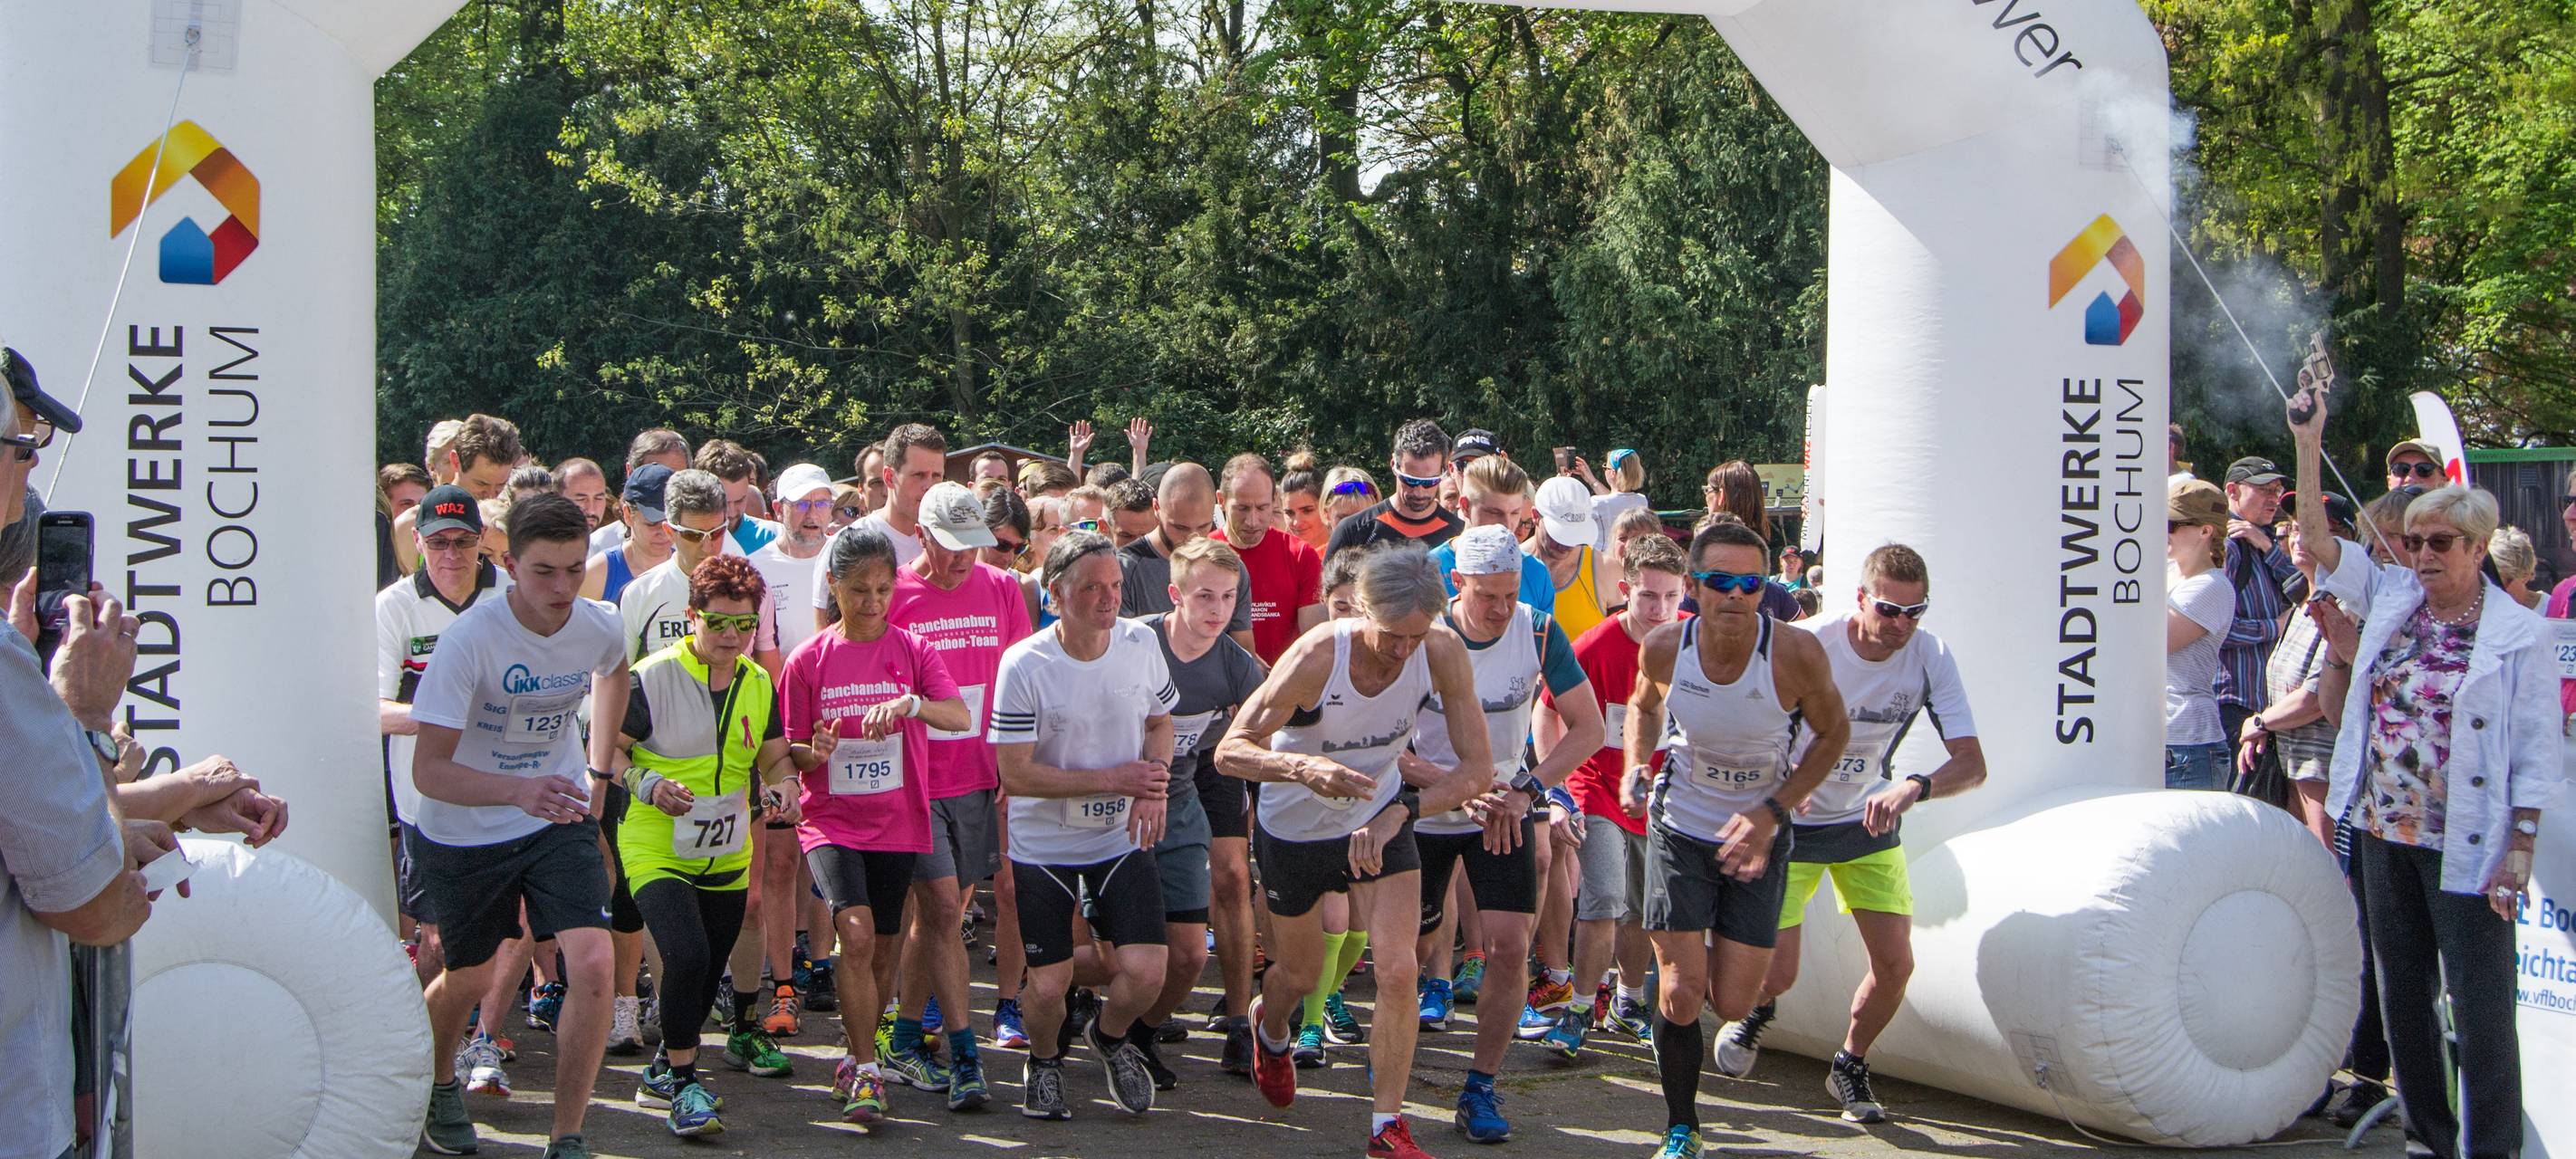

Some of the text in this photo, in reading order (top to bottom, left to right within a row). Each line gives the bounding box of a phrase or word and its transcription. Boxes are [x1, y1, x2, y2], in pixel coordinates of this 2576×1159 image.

[1457, 435, 1490, 447] PING
[207, 327, 259, 606] BOCHUM
[2113, 378, 2144, 604] BOCHUM
[436, 503, 465, 515] WAZ
[2056, 378, 2100, 744] STADTWERKE
[908, 615, 996, 635] Canchanabury
[822, 704, 871, 721] Maratho
[1174, 733, 1197, 746] 78
[845, 761, 891, 780] 1795
[1706, 766, 1760, 782] 2165
[1834, 758, 1866, 773] 73
[1081, 798, 1126, 817] 1958
[694, 814, 736, 848] 727
[2515, 944, 2576, 984] ichta
